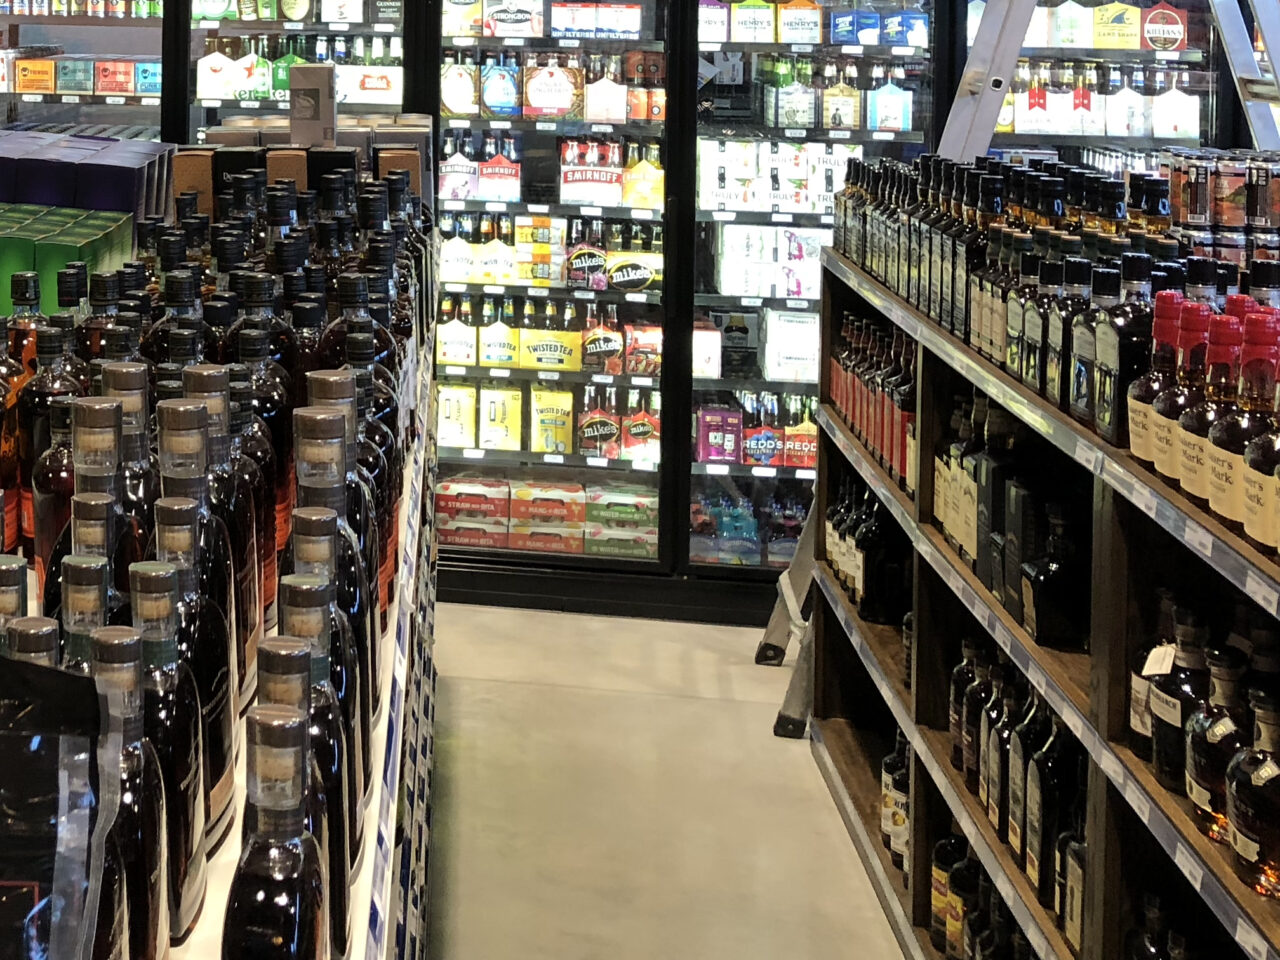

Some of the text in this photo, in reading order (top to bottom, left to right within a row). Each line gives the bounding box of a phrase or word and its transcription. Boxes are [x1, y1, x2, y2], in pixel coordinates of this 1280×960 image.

[493, 12, 531, 21] STRONGBOW
[817, 156, 846, 167] TRULY
[482, 166, 516, 176] SMIRNOFF
[567, 171, 618, 182] SMIRNOFF
[572, 254, 604, 269] mike's
[612, 268, 652, 283] mike's
[527, 344, 573, 357] TWISTED TEA
[587, 339, 621, 354] mike's
[584, 424, 618, 437] mike's
[630, 424, 652, 433] mike's
[744, 439, 783, 450] REDD'S
[787, 441, 816, 451] REDD
